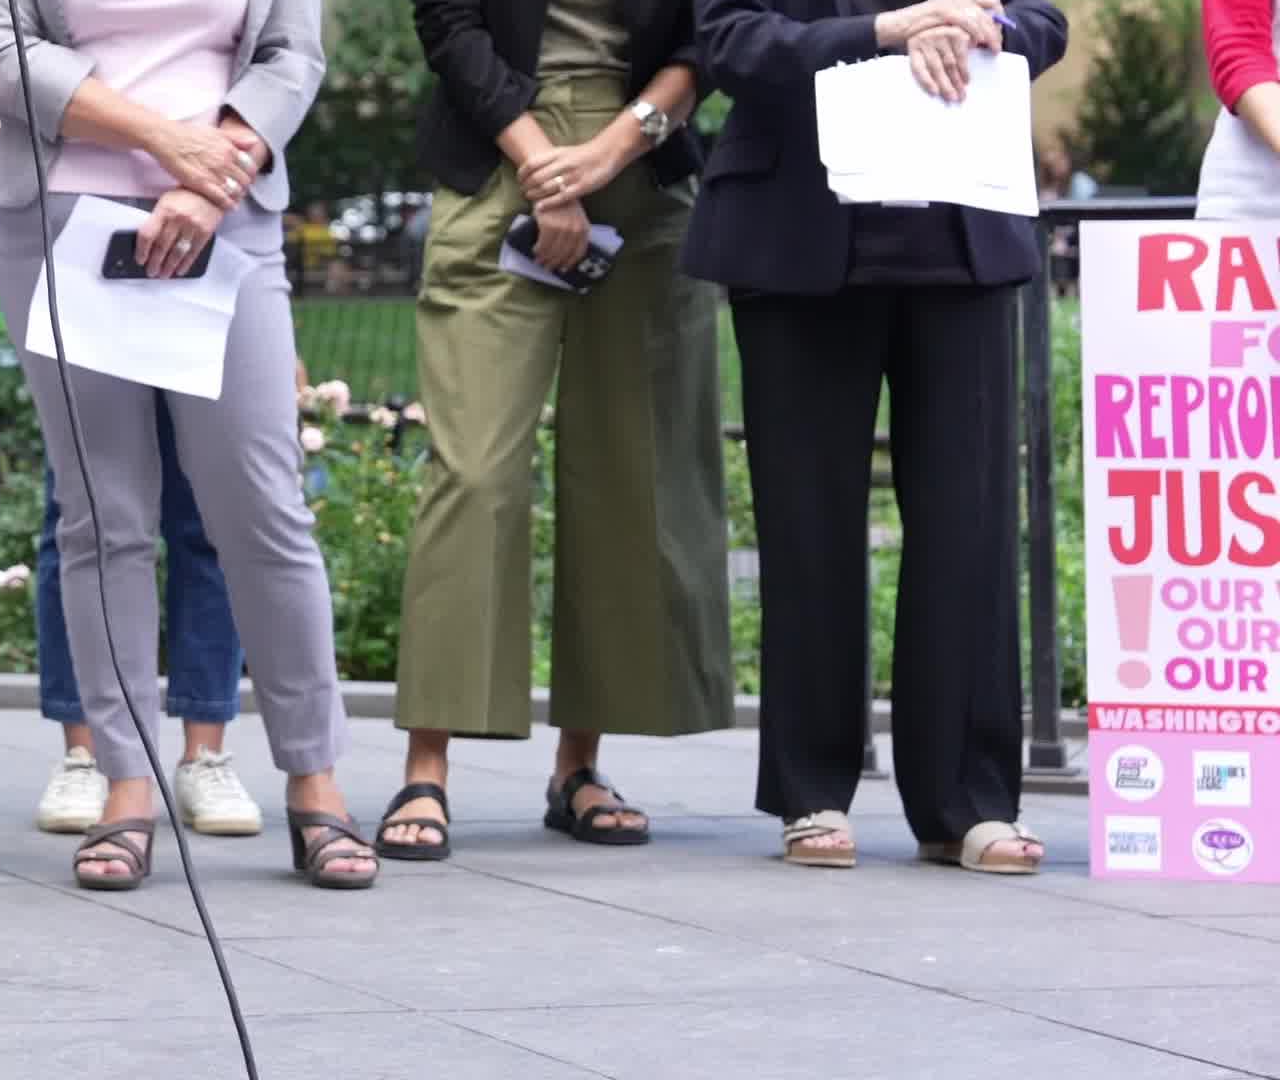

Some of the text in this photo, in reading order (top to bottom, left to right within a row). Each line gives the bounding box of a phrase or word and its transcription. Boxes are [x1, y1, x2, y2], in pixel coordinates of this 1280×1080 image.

[1137, 234, 1280, 311] RA
[1095, 374, 1280, 459] REPRO
[1161, 577, 1263, 612] OUR
[1177, 617, 1280, 652] OUR
[1164, 657, 1268, 692] OUR
